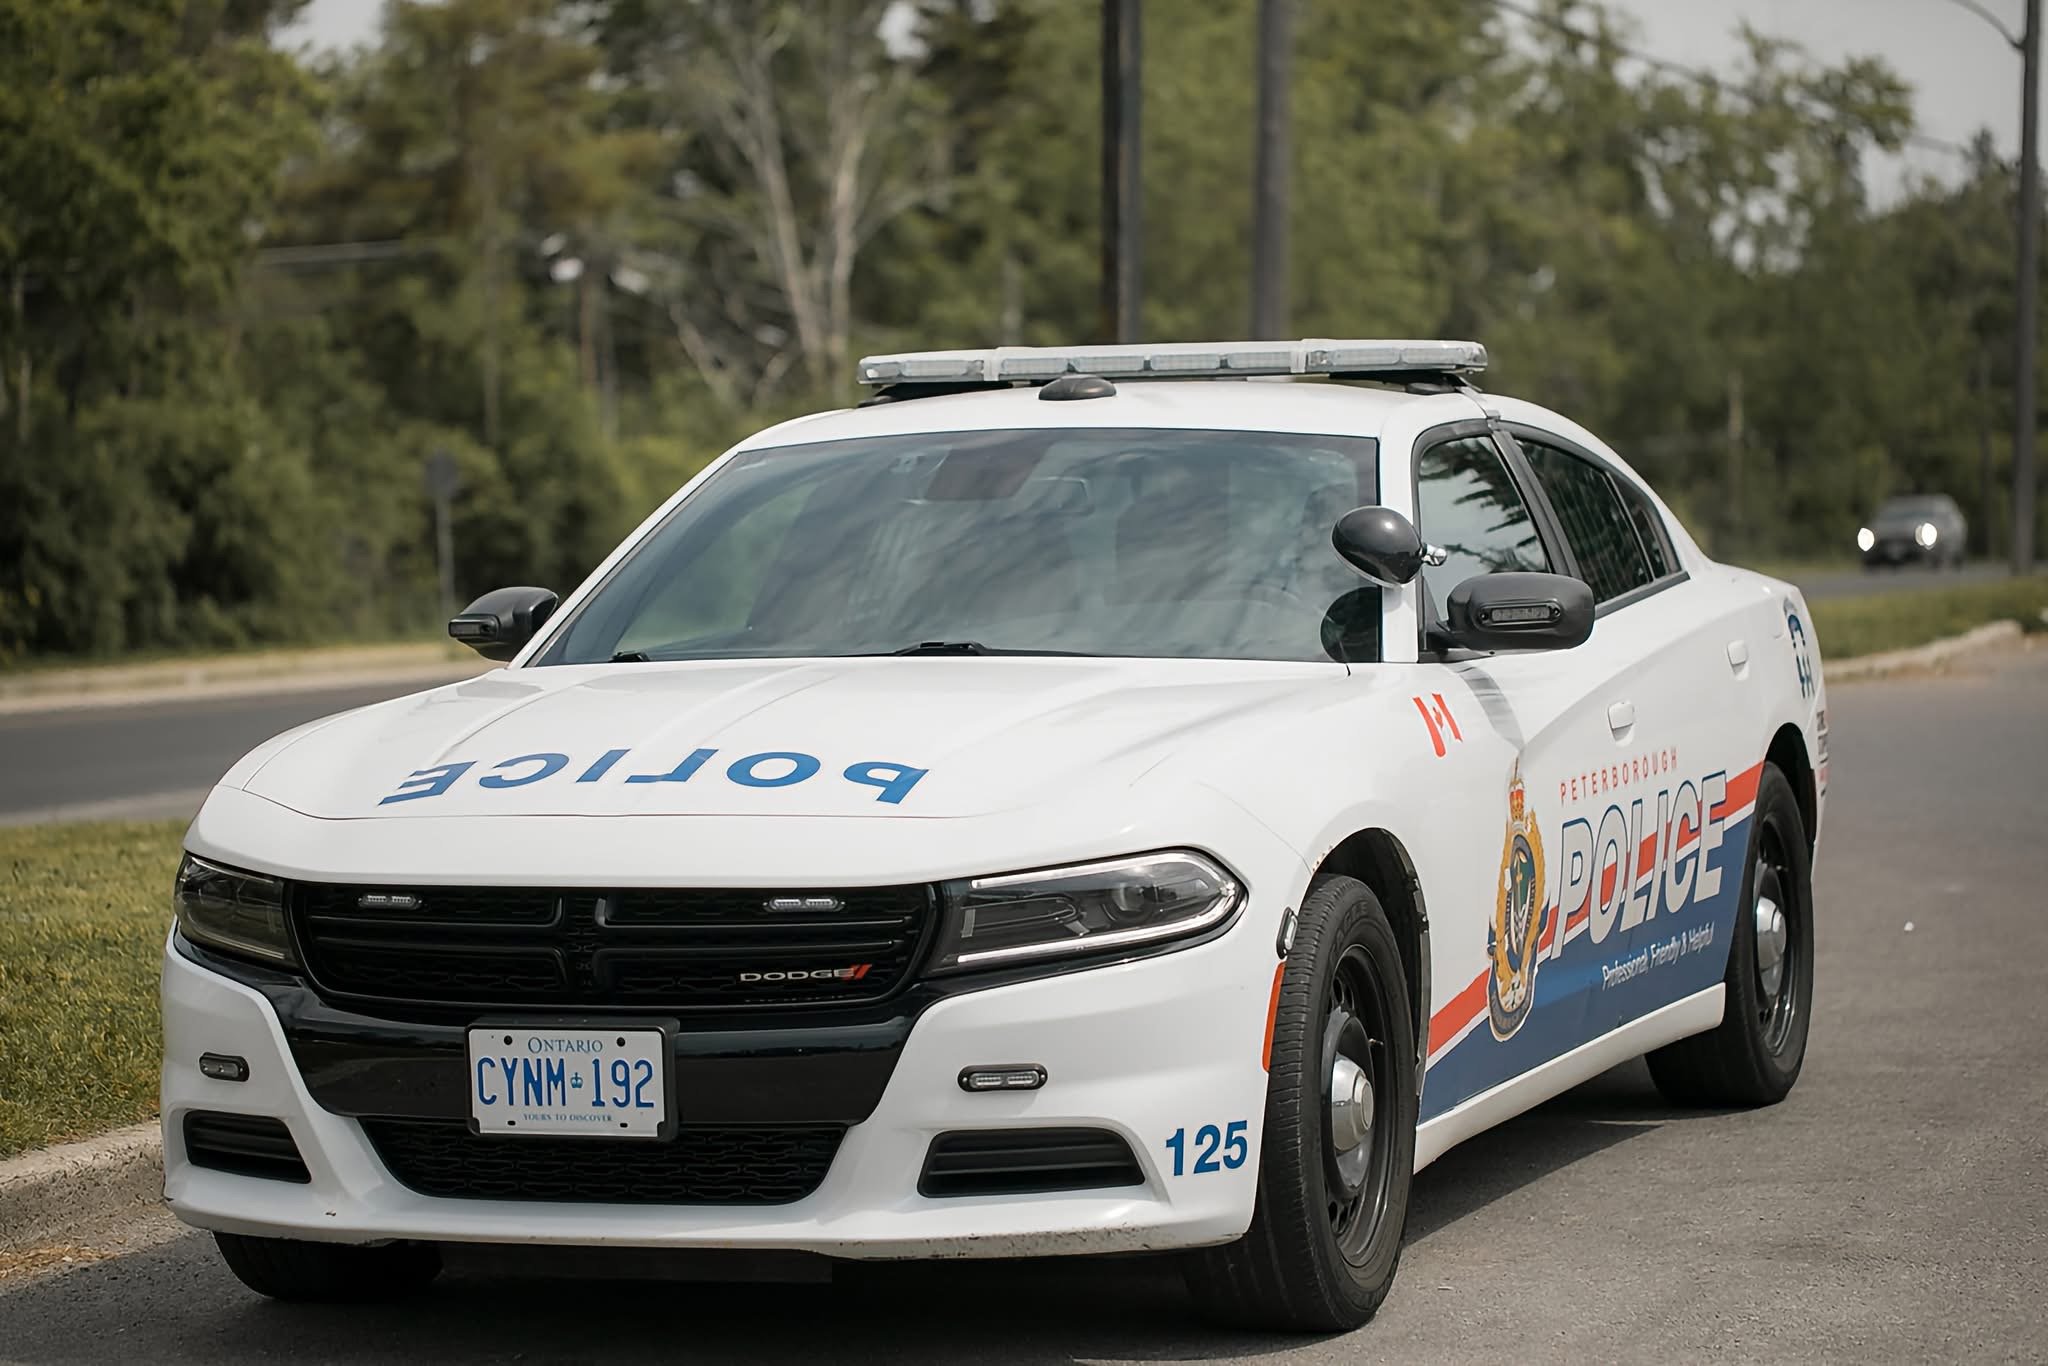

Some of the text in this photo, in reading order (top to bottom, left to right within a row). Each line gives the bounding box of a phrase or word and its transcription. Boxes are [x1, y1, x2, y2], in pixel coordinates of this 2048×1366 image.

[1559, 747, 1678, 807] PETERBOROUGH
[1551, 769, 1727, 961] POLICE
[740, 968, 855, 981] DODGE
[527, 1036, 603, 1054] ONTARIO
[477, 1057, 655, 1108] CYNM 192
[523, 1113, 612, 1122] YOURS TO DISCOVER
[1165, 1120, 1248, 1176] 125
